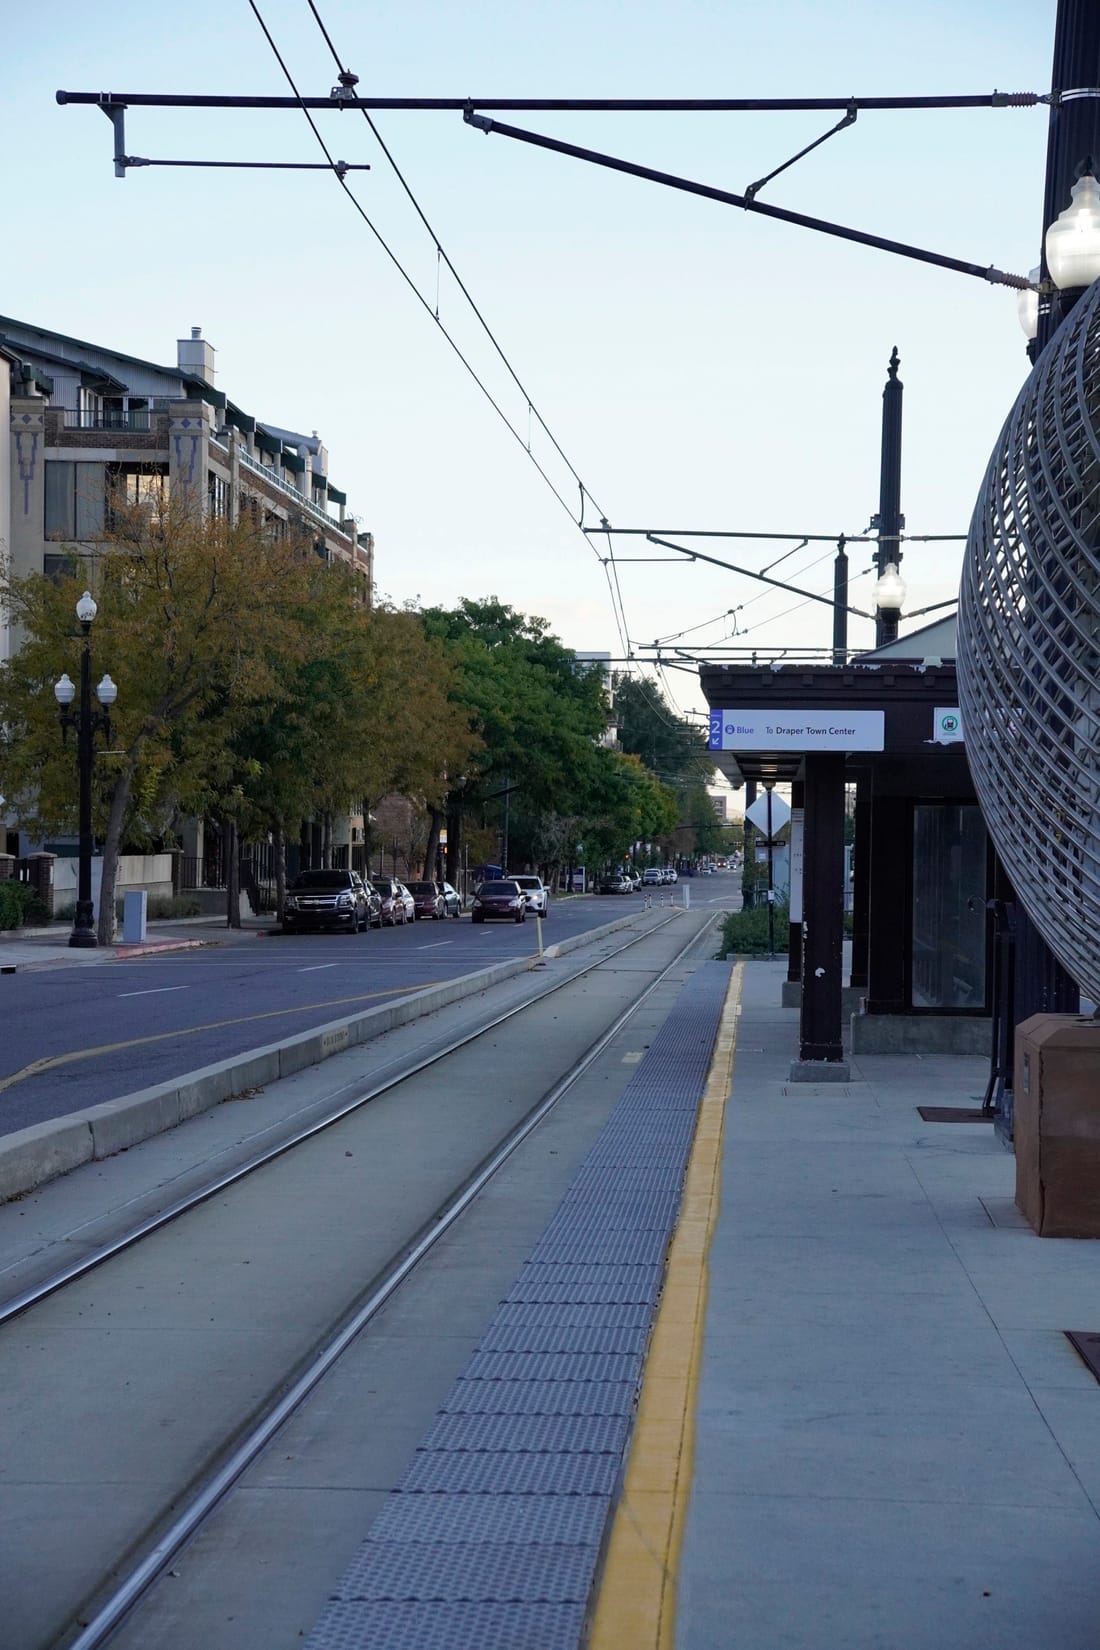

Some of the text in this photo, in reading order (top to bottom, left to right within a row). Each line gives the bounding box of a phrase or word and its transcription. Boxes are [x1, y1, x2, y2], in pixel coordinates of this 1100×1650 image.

[711, 721, 720, 734] 2
[736, 726, 856, 736] Blue To Draper Town Center
